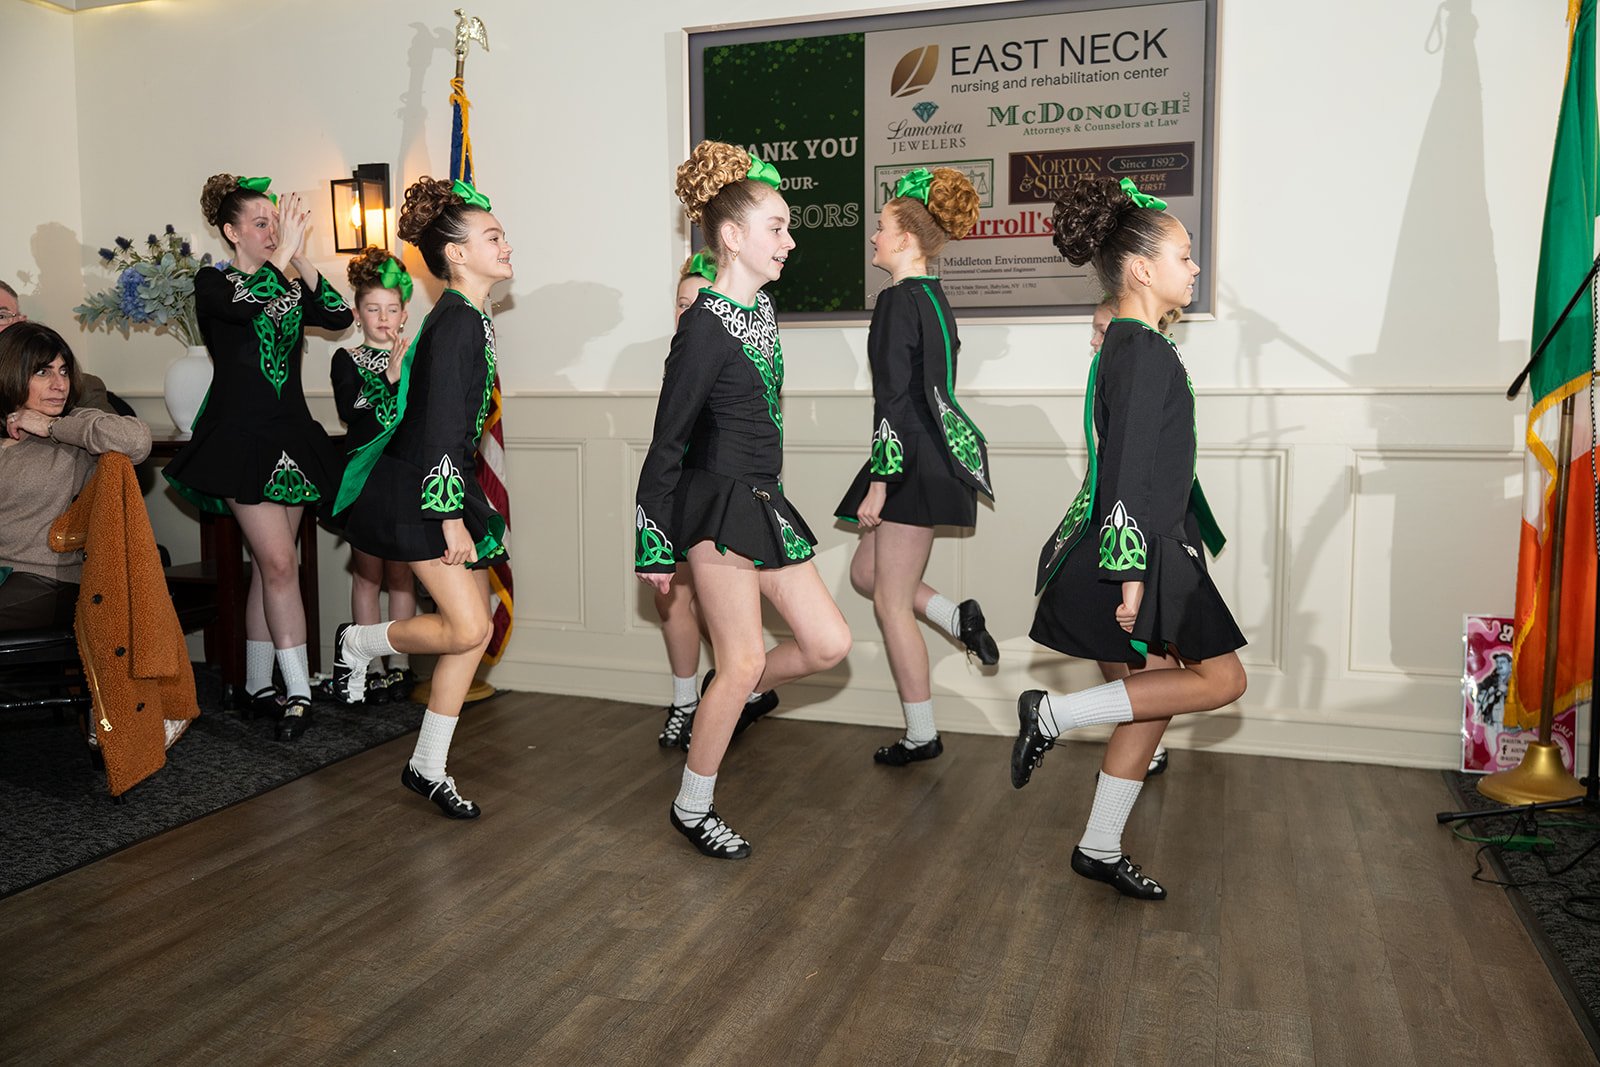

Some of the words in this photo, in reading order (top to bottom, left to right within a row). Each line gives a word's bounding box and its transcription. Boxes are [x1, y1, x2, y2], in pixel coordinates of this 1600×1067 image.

[951, 38, 1048, 76] EAST
[1060, 28, 1168, 67] NECK
[951, 79, 999, 93] nursing
[1002, 76, 1027, 89] and
[1031, 69, 1120, 87] rehabilitation
[1123, 66, 1169, 80] center
[887, 119, 963, 139] Lamonica
[1023, 125, 1070, 136] Attorneys
[1074, 124, 1082, 132] &
[1085, 120, 1141, 132] Counselors
[1144, 119, 1153, 128] at
[1157, 118, 1178, 127] Law
[748, 141, 799, 162] ANK
[803, 136, 858, 160] YOU
[892, 138, 966, 155] JEWELERS
[1024, 154, 1103, 178] NORTON
[1120, 159, 1147, 170] Since
[1151, 157, 1175, 168] 1892
[1019, 178, 1034, 192] &
[1140, 173, 1167, 182] SERVE
[1140, 182, 1167, 191] FIRST!
[789, 203, 859, 230] SORS
[969, 211, 1053, 236] arroll's
[944, 256, 992, 266] Middleton
[995, 255, 1066, 265] Environmental
